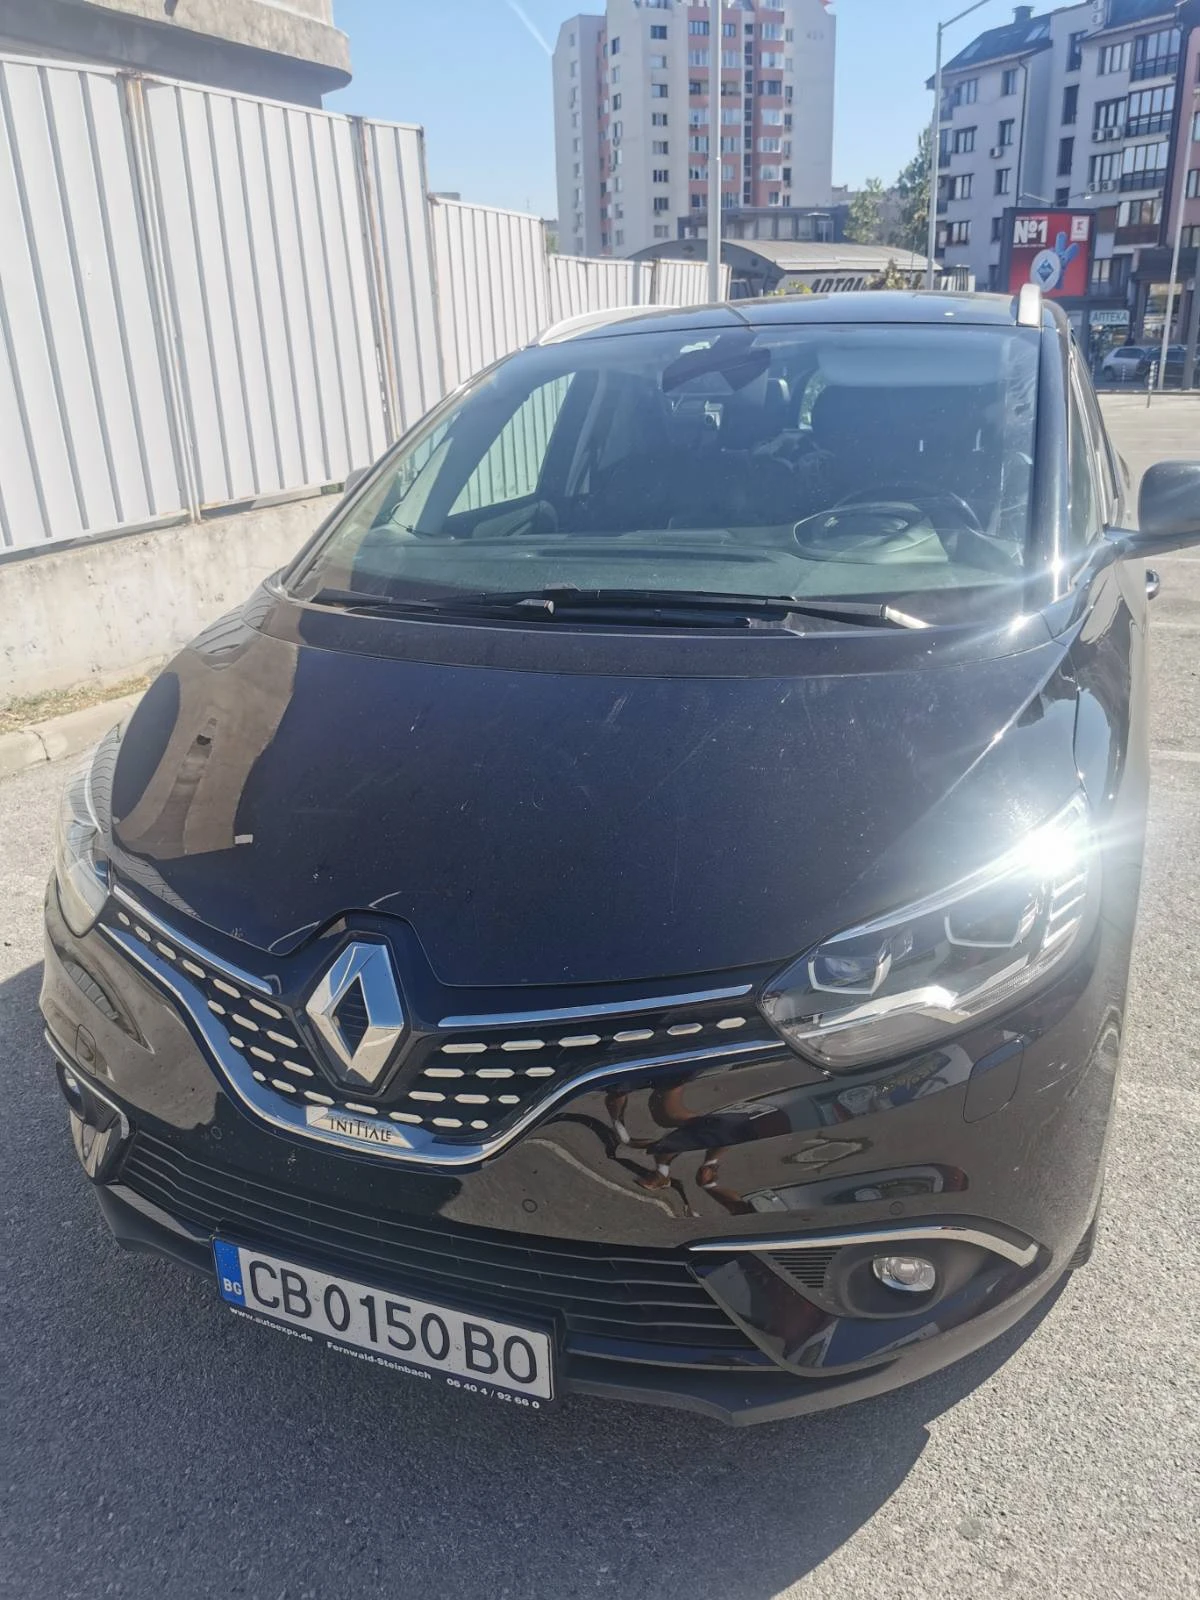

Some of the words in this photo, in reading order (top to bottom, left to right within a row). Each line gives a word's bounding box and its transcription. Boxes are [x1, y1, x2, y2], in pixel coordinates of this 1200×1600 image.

[1092, 311, 1127, 322] АПТЕКА
[330, 1118, 392, 1142] INITIALE
[223, 1277, 243, 1296] BG
[229, 1307, 314, 1342] www.autoexpo.de
[249, 1260, 312, 1319] CB
[324, 1284, 450, 1360] 0150
[463, 1321, 538, 1384] BO
[326, 1341, 432, 1380] Fernwald-Steinbach
